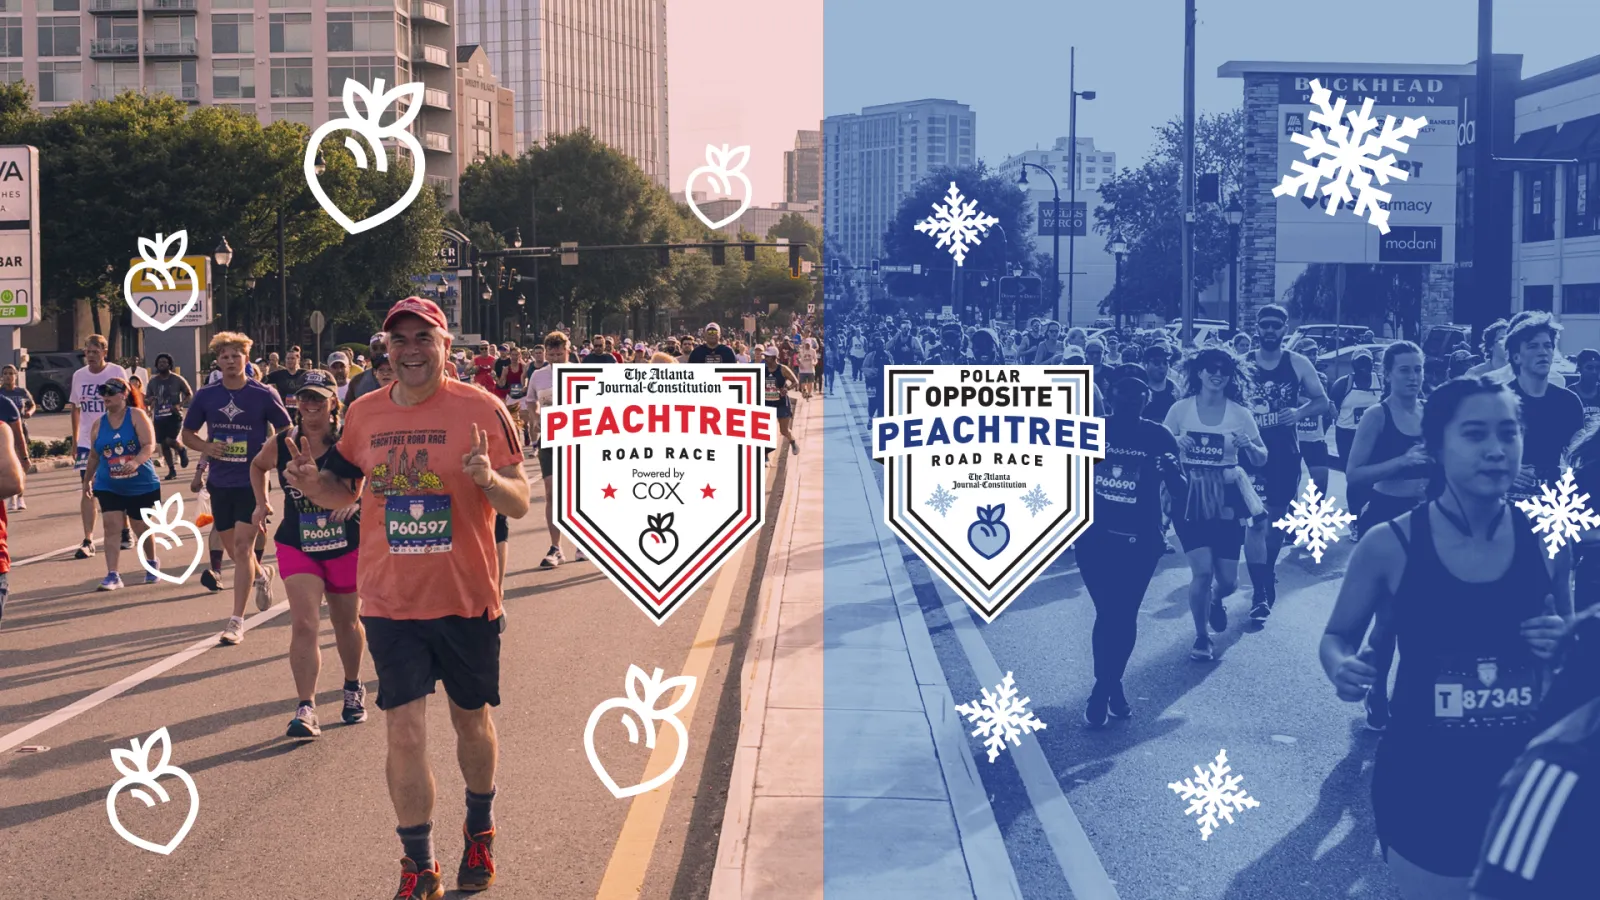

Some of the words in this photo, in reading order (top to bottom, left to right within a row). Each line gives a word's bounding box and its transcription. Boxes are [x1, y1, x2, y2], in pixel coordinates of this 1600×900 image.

[1386, 231, 1436, 249] modani
[80, 401, 107, 412] DELT
[370, 435, 405, 448] PEACHTREE
[407, 434, 426, 445] ROAD
[428, 434, 446, 445] RACE
[1095, 475, 1137, 491] P60690
[303, 526, 343, 539] P60614
[389, 520, 448, 535] P60597
[1438, 691, 1452, 709] T
[1462, 687, 1533, 709] 87345
